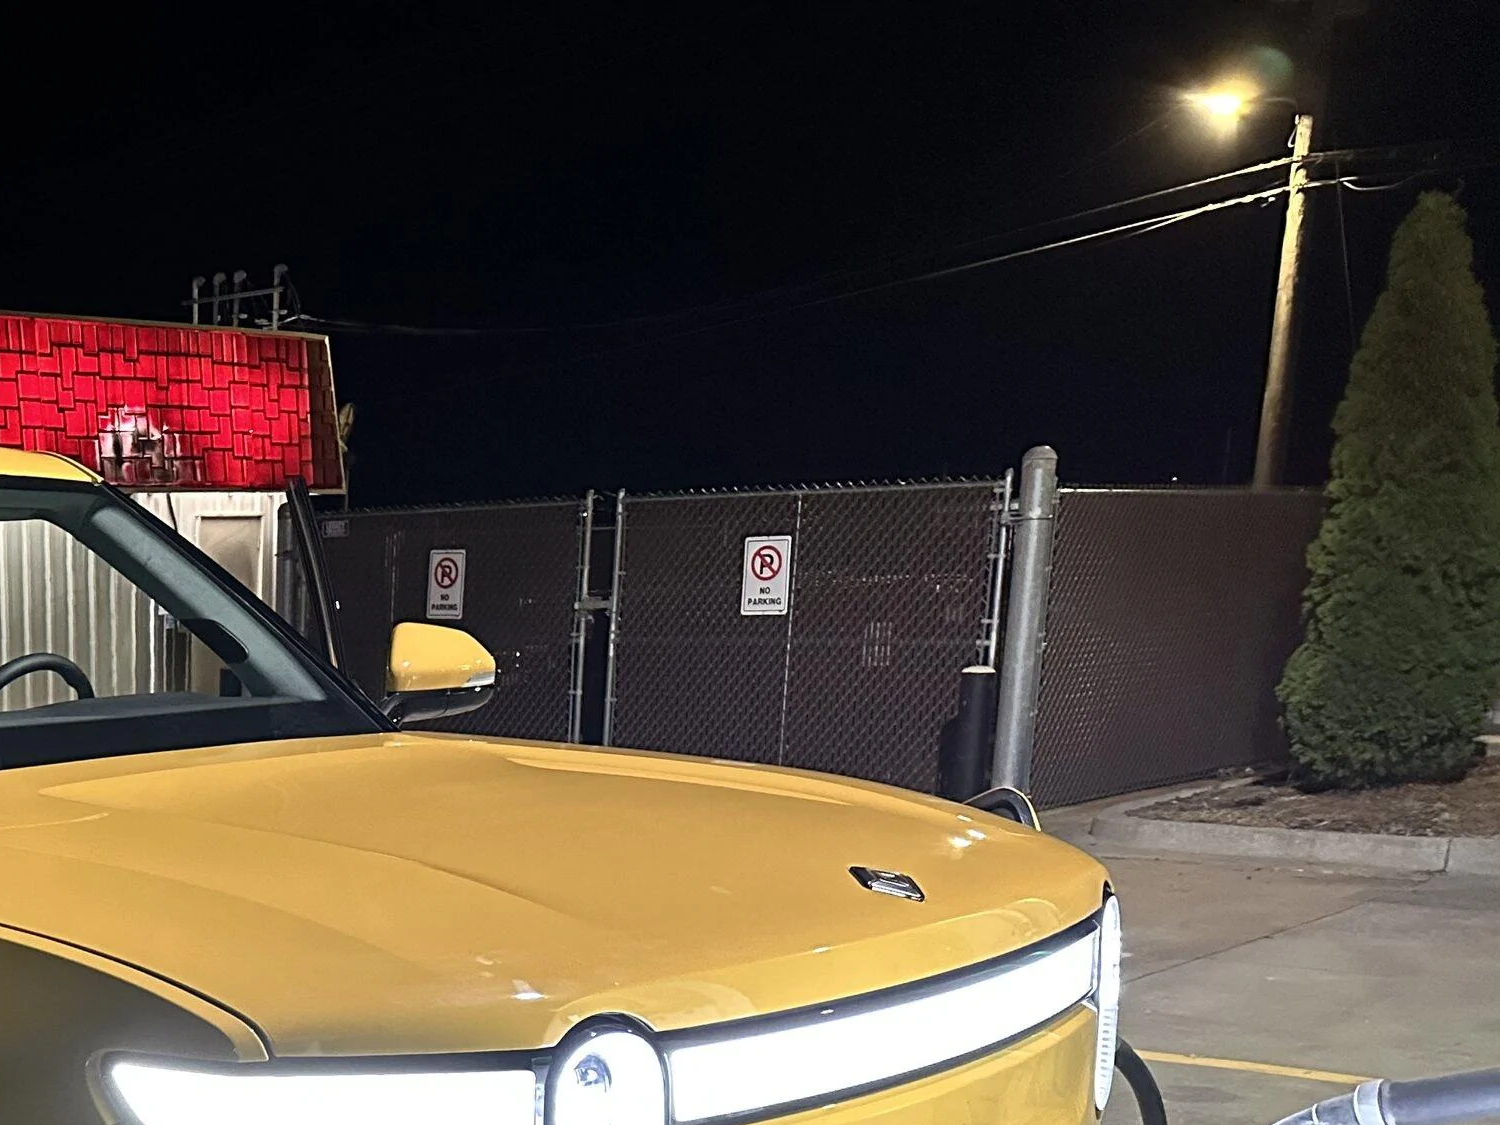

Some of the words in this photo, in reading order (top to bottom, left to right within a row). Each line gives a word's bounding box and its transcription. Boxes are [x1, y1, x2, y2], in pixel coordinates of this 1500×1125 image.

[759, 586, 771, 595] NO
[440, 593, 450, 601] NO
[747, 597, 782, 606] PARKING
